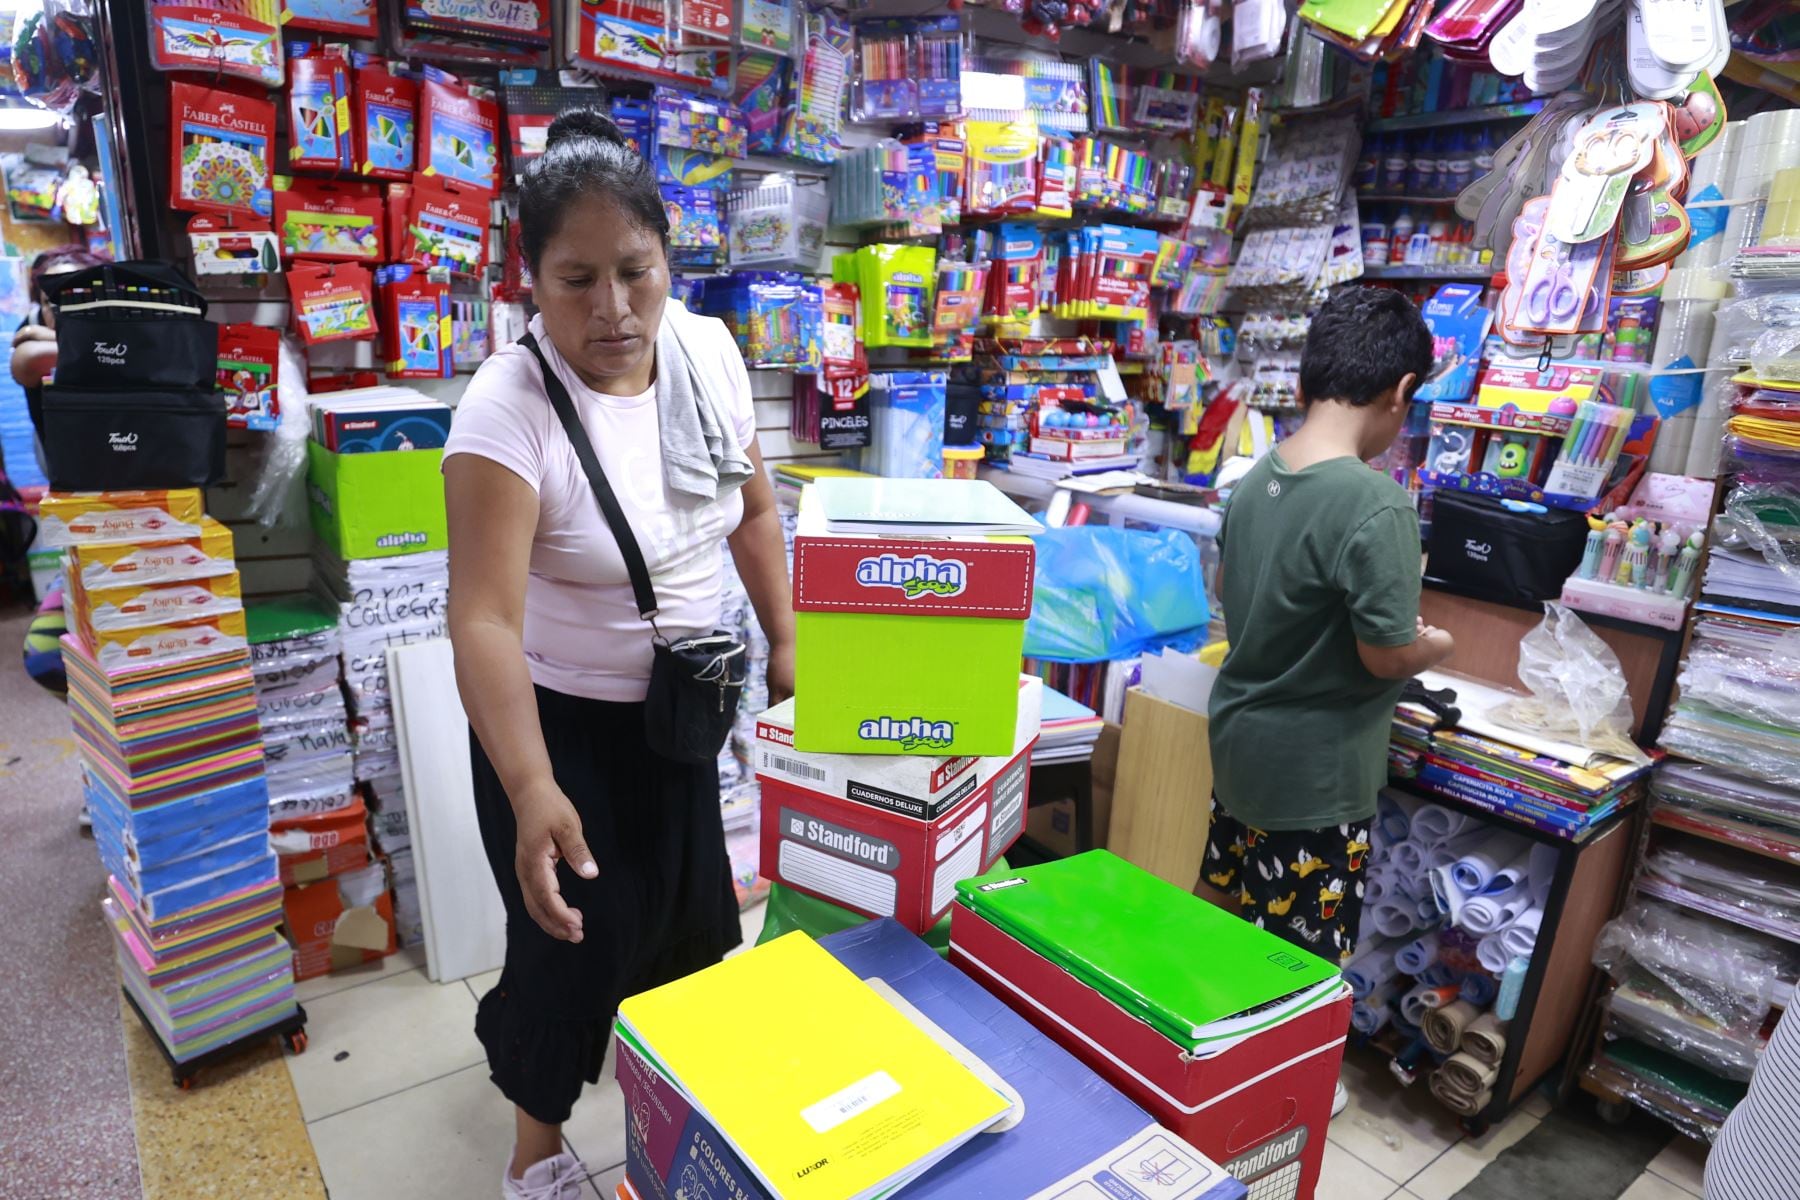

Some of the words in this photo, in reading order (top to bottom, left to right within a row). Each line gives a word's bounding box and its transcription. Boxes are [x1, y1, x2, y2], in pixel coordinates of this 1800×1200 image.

[487, 0, 522, 24] Soft
[183, 105, 267, 133] FABER-CASTELL
[836, 379, 852, 397] 12
[821, 416, 869, 429] PINCELES
[377, 532, 427, 548] alpha
[857, 556, 962, 586] alpha
[769, 729, 793, 744] Stand
[857, 716, 954, 746] alpha
[1453, 774, 1494, 792] CAPERUCITA
[1494, 787, 1514, 799] ROJA
[851, 788, 894, 806] CUADERNOS
[895, 799, 923, 813] DELUXE
[1487, 794, 1507, 806] ROJA
[807, 820, 888, 865] Standford
[694, 1131, 701, 1143] 6
[700, 1140, 736, 1192] COLORES
[796, 1157, 828, 1178] LUXOR
